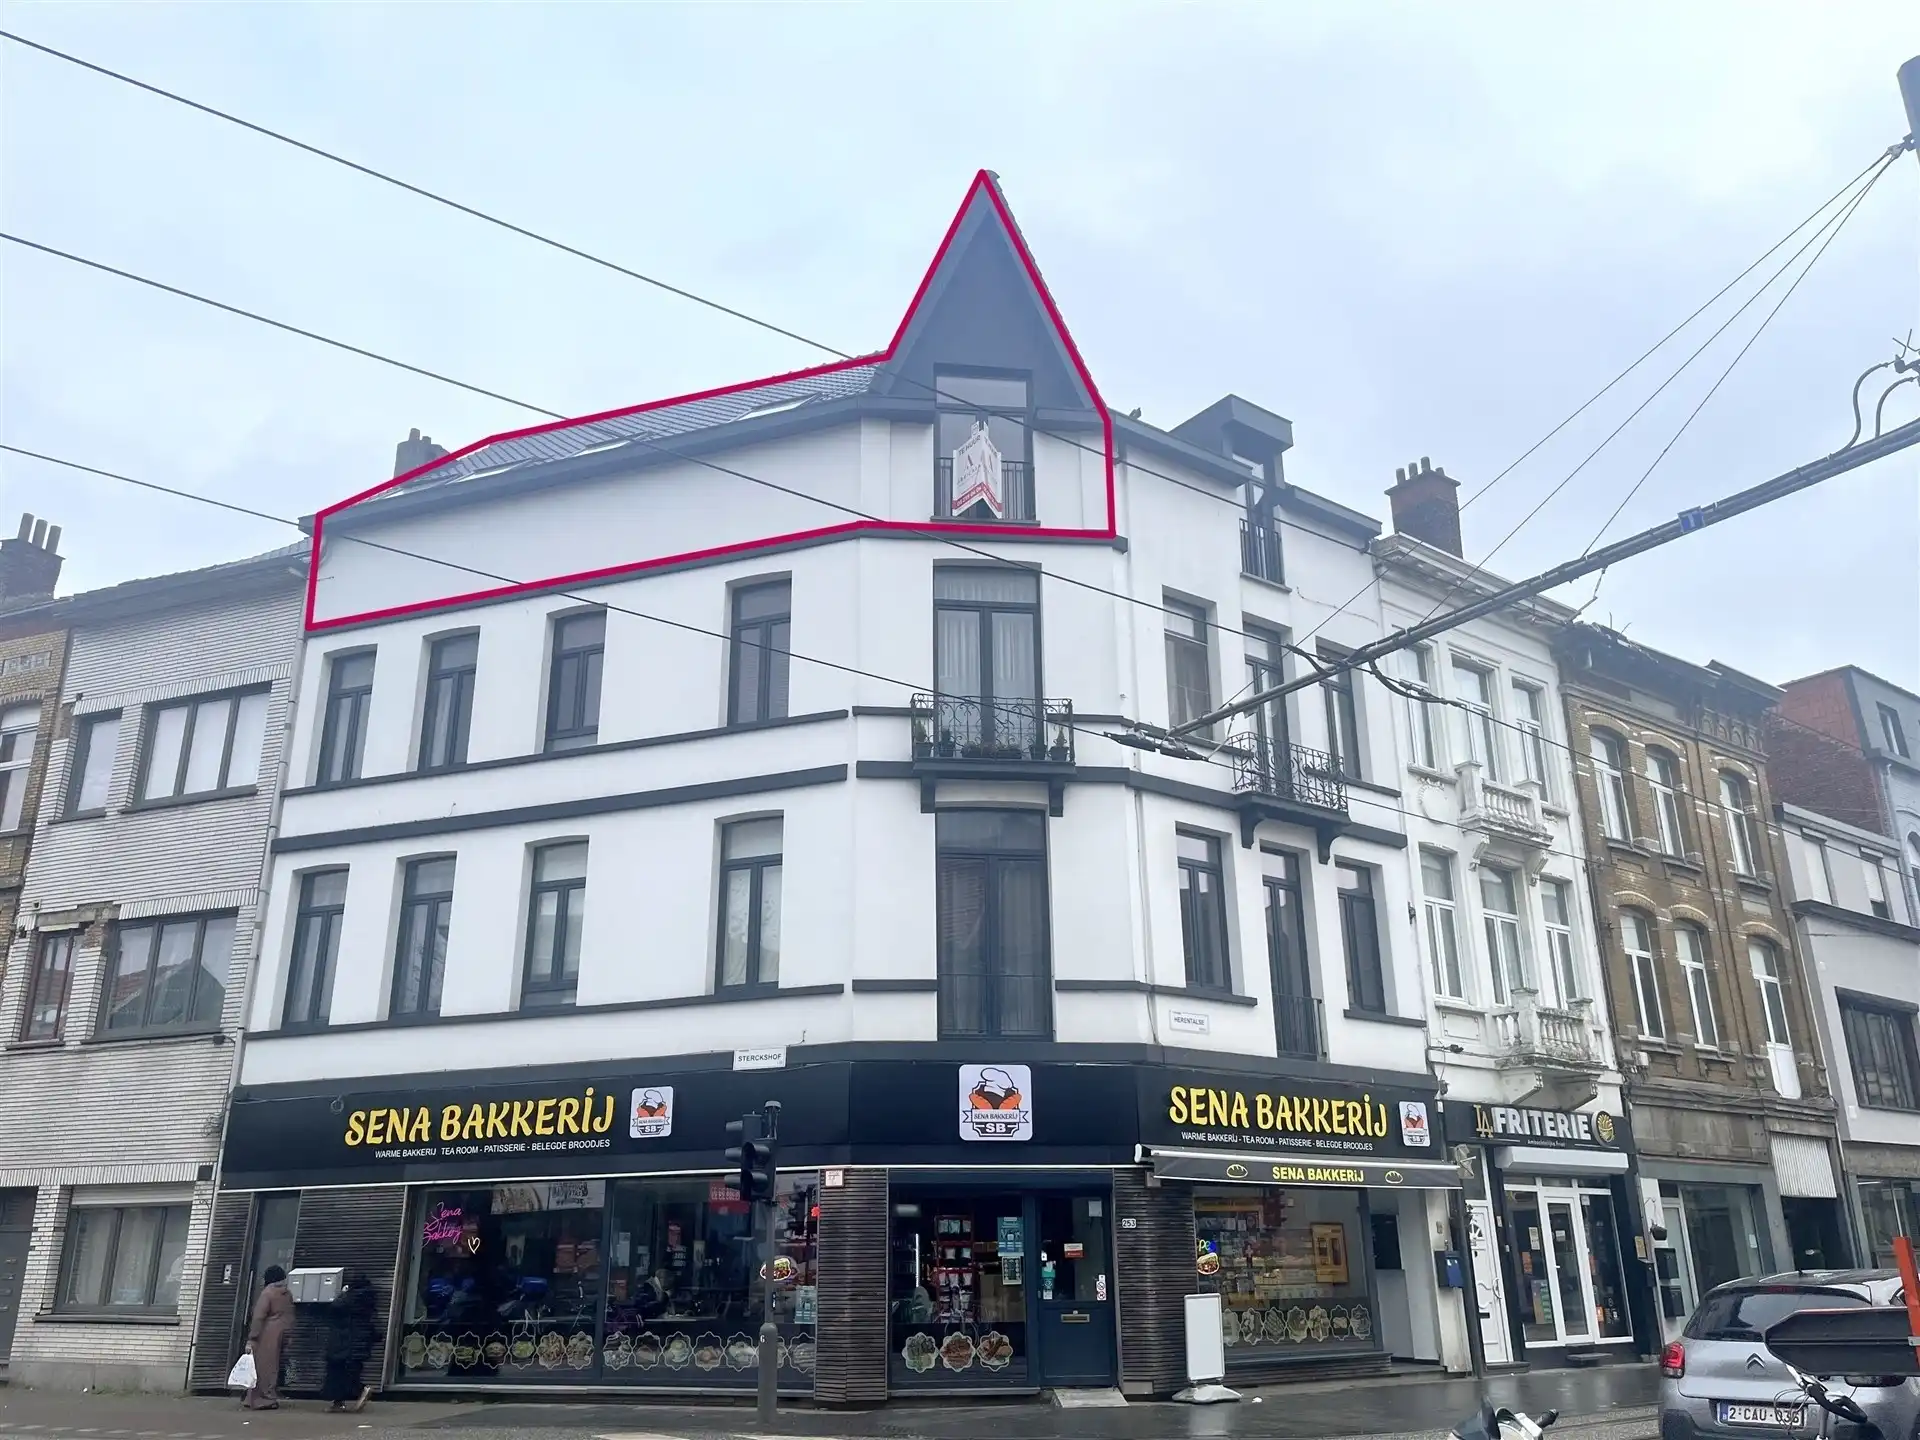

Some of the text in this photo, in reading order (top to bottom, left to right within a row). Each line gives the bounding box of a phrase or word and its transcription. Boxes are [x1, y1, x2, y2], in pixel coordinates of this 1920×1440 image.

[1173, 1016, 1205, 1026] HERENTALSE
[738, 1053, 782, 1062] STERCKSHOF
[1169, 1085, 1250, 1129] SENA
[344, 1106, 432, 1147] SENA
[985, 1123, 1006, 1133] SB
[1473, 1104, 1592, 1141] LA FRITERIE
[375, 1149, 401, 1159] WARME
[441, 1147, 456, 1156] TEA
[456, 1146, 478, 1155] ROOM
[483, 1143, 526, 1153] PATISSERIE
[531, 1141, 567, 1151] BELEGDE
[568, 1139, 611, 1149] BROODJES
[1181, 1131, 1207, 1142] WARME
[1242, 1135, 1256, 1144] TEA
[1256, 1136, 1274, 1145] ROOM
[1278, 1137, 1312, 1147] PATISSERIE
[1315, 1140, 1342, 1149] BELEGDE
[1343, 1141, 1373, 1151] BROODJES
[1272, 1166, 1305, 1180] SENA
[1122, 1219, 1136, 1227] 253
